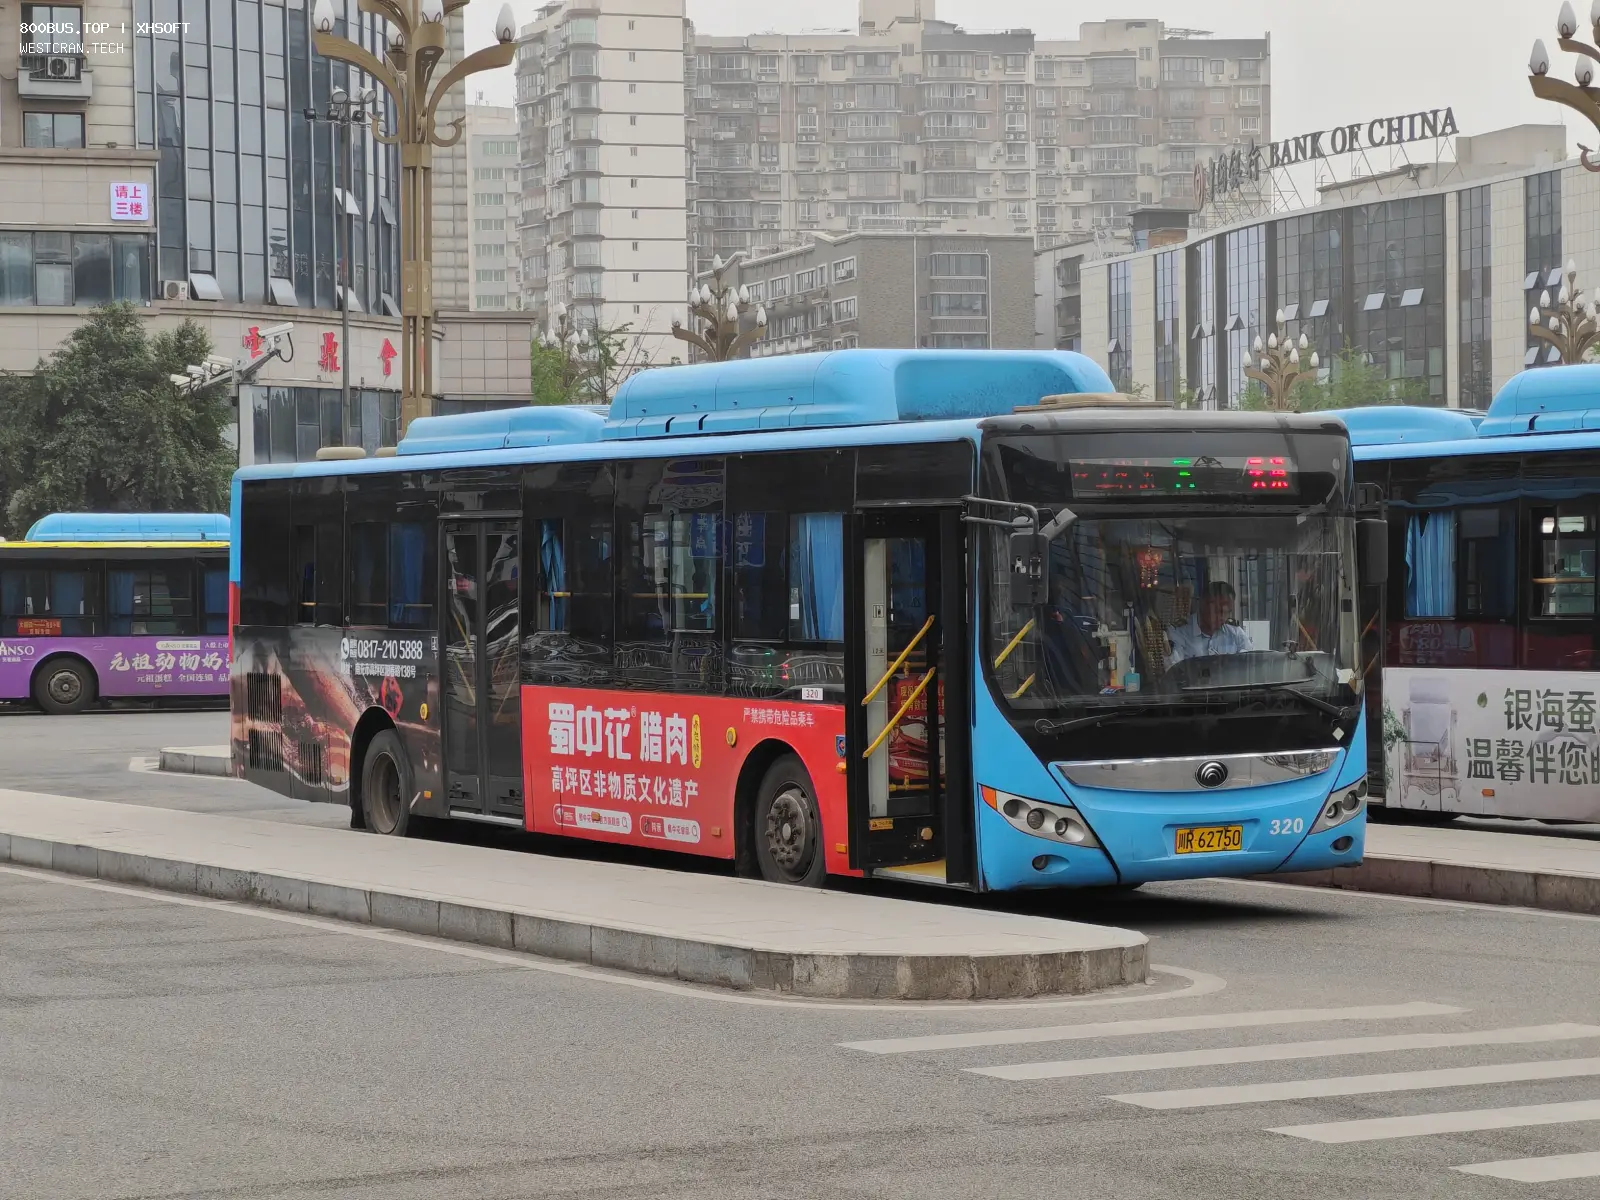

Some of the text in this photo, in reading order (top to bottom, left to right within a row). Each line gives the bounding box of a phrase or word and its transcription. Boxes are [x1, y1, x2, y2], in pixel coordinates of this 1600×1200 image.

[1269, 106, 1460, 168] BANK OF CHINA
[115, 185, 142, 199] 请上
[115, 202, 142, 215] 三楼
[399, 640, 423, 660] 5888
[109, 651, 229, 672] 元祖动物奶
[806, 689, 819, 699] 320
[743, 707, 814, 727] 严禁携带危险品乘车
[1503, 688, 1600, 734] 银海蚕
[548, 703, 688, 766] 蜀中花 腊肉
[551, 765, 699, 808] 高坪区非物质文化遗产
[1269, 817, 1303, 835] 320
